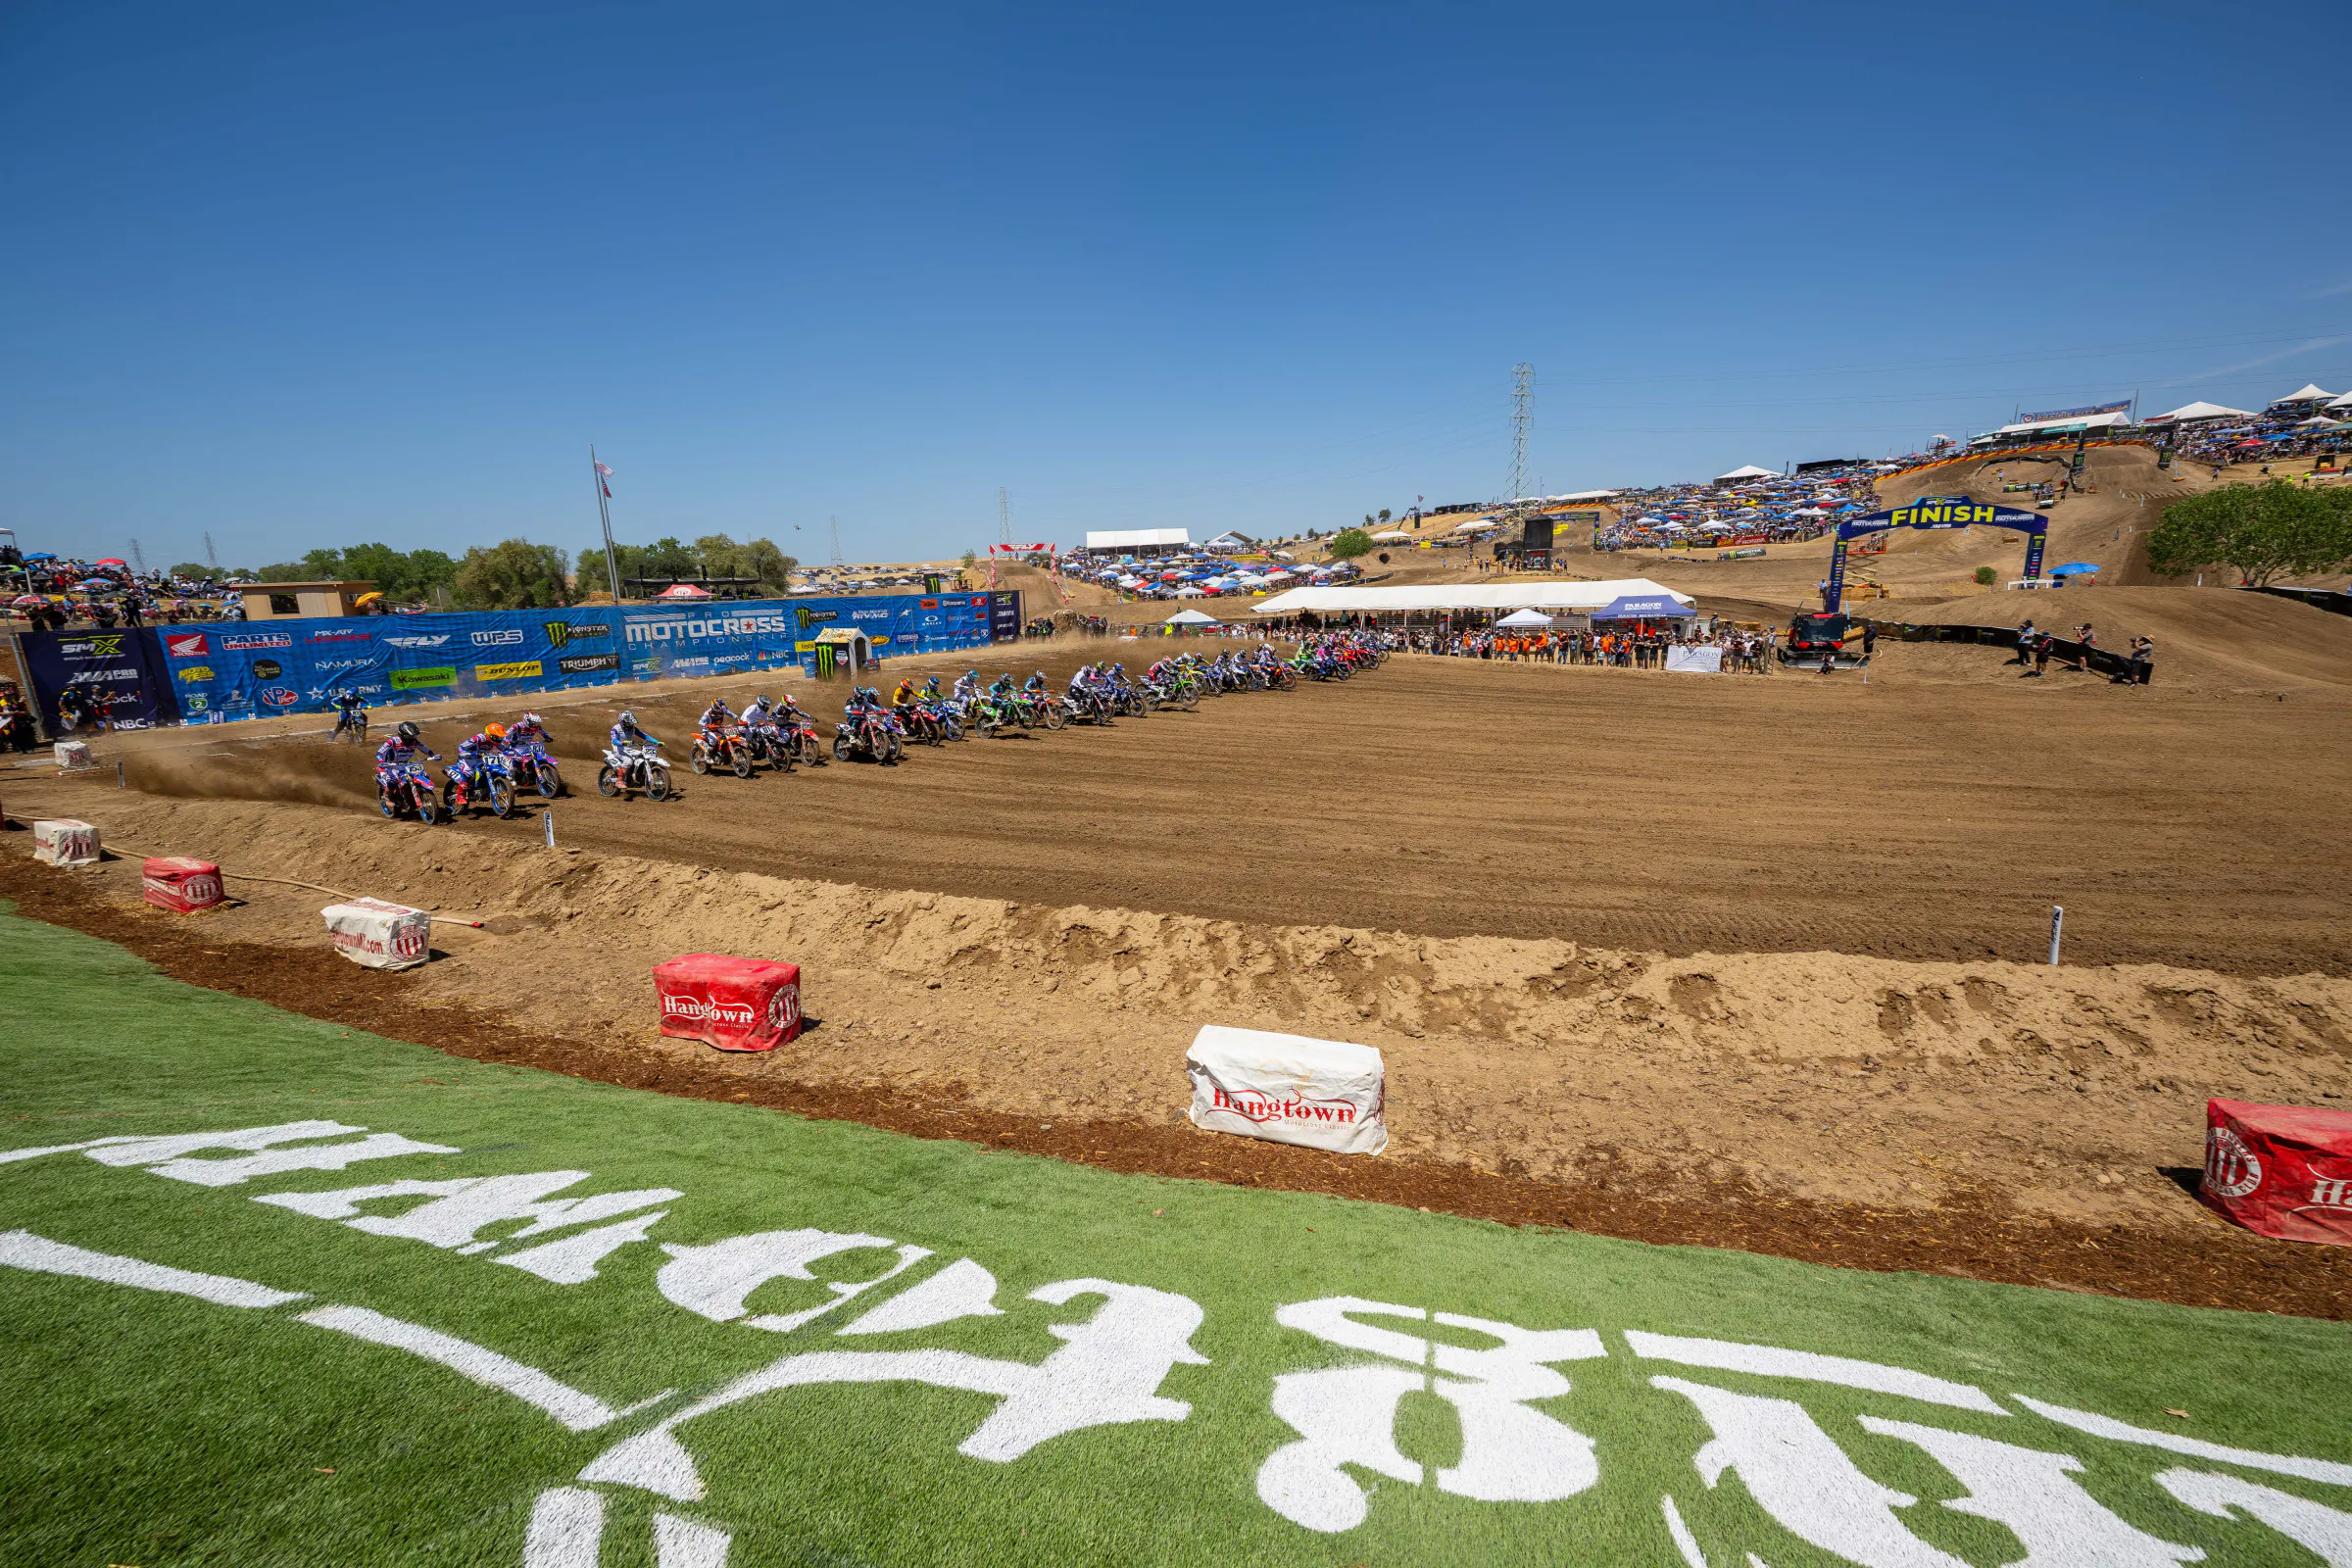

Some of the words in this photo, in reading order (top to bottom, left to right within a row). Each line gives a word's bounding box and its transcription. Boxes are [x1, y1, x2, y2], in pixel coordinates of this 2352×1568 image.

[1890, 506, 1994, 526] FINISH
[687, 611, 730, 619] PRO
[566, 624, 609, 634] MONSTER
[625, 616, 786, 643] MOTOCROSS
[220, 632, 291, 646] PARTS
[471, 630, 523, 646] WPS
[628, 633, 787, 651] CHAMPIONSHIP
[61, 638, 122, 655] SMX
[223, 640, 292, 650] UNLIMITED
[713, 652, 751, 665] peacock
[771, 650, 790, 660] NBC
[315, 658, 378, 670] NAMURA
[490, 664, 539, 674] DUNLOP
[560, 658, 607, 670] TRIUMPH
[632, 660, 662, 671] SMX
[178, 666, 210, 679] MOTO
[186, 670, 215, 683] TEES
[397, 672, 450, 684] Kawasaki
[262, 687, 286, 706] VP
[194, 701, 204, 710] 2
[113, 718, 146, 730] NBC
[447, 771, 460, 781] 171
[1204, 1082, 1358, 1124] Hangtown
